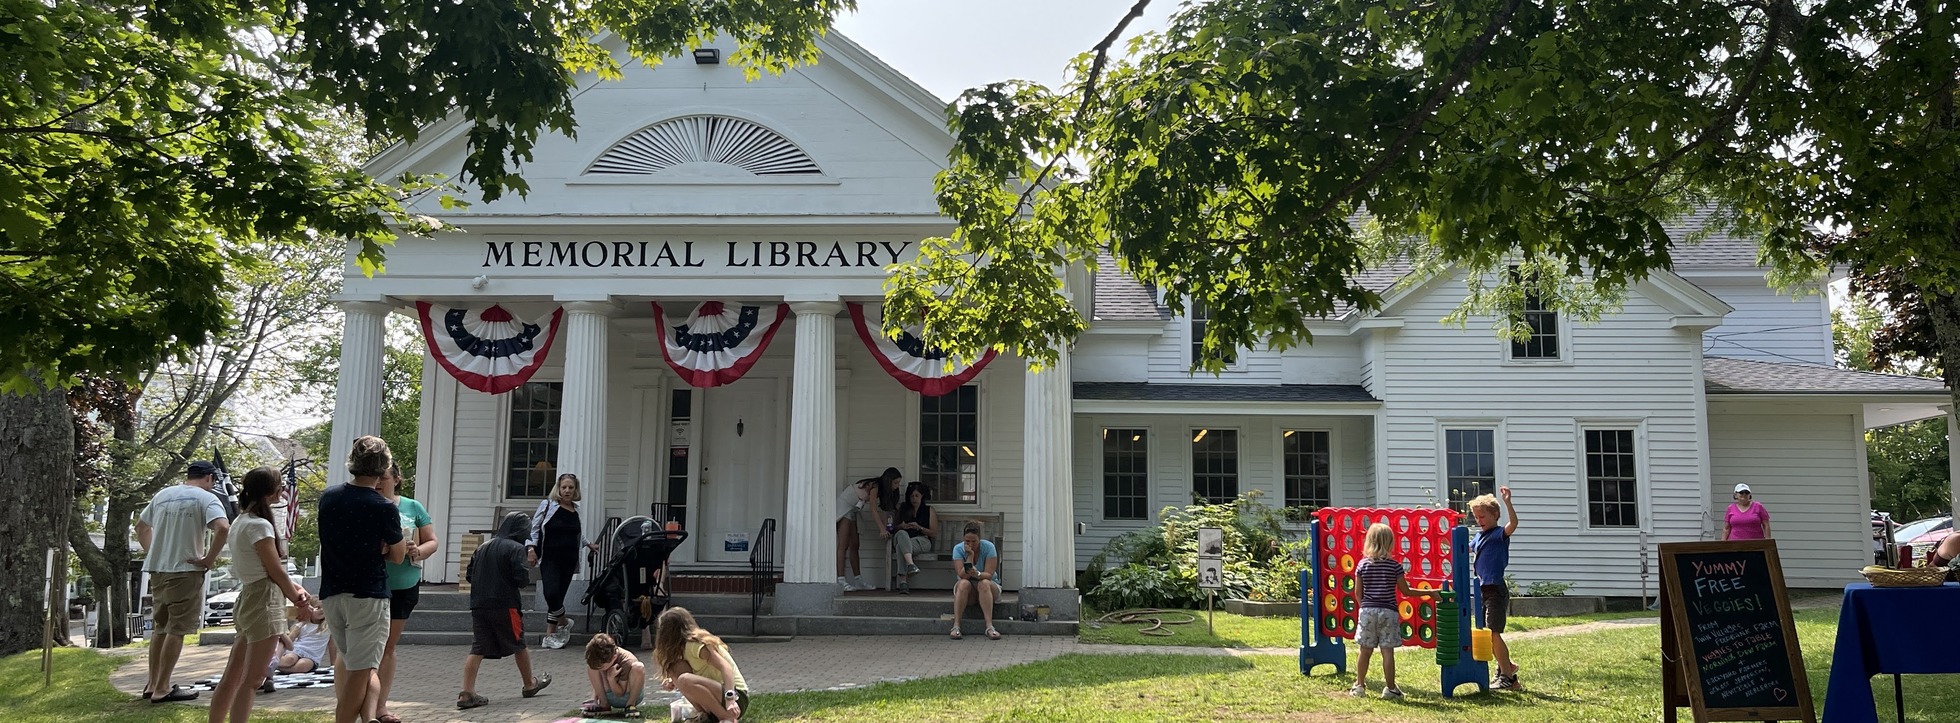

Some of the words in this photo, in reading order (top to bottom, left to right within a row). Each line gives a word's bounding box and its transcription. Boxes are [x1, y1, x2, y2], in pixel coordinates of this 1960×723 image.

[482, 240, 705, 268] MEMORIAL
[726, 241, 913, 267] LIBRARY
[1691, 559, 1747, 577] YUMMY
[1694, 577, 1746, 598] FREE
[1697, 620, 1719, 632] FROM
